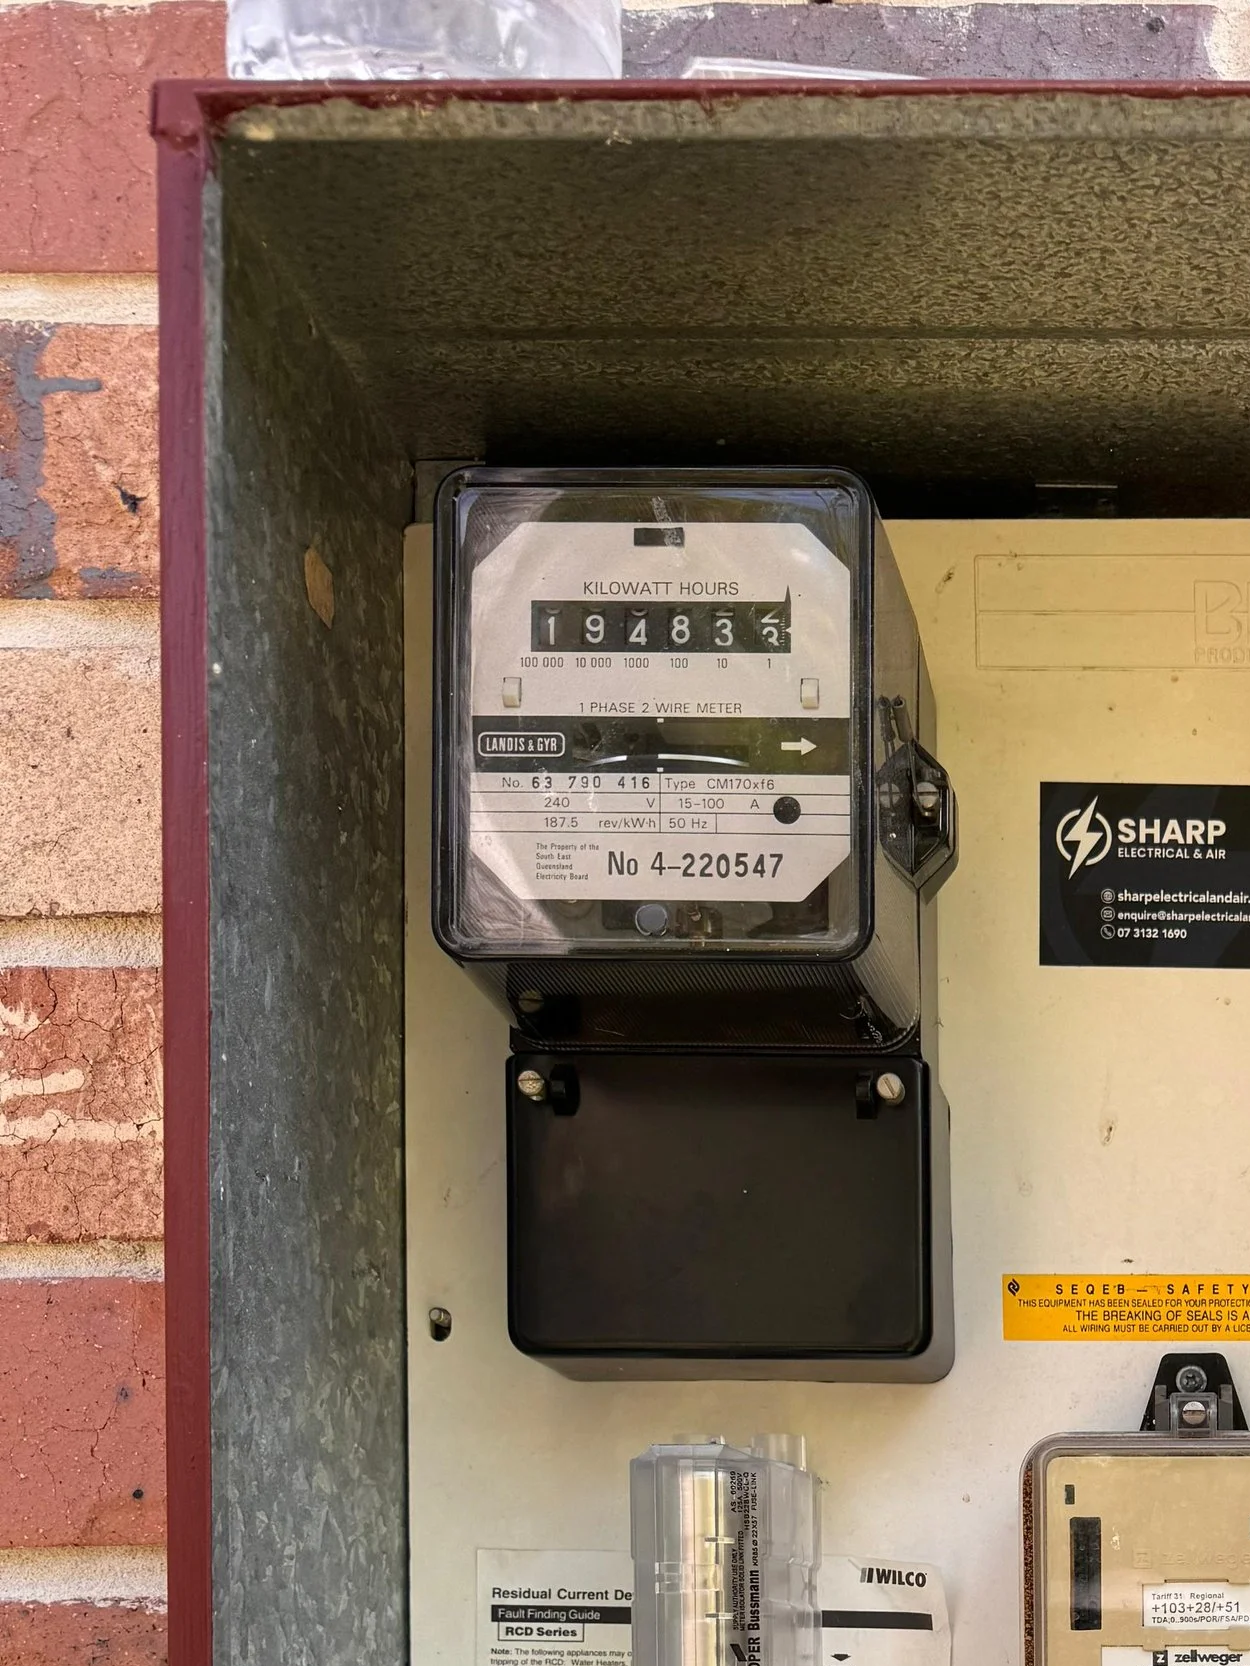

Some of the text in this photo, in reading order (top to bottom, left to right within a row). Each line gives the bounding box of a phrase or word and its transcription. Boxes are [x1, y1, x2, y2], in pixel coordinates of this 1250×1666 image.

[584, 582, 738, 595] KILOWATT HOURS
[591, 702, 634, 713] PHASE
[642, 703, 649, 713] 2
[656, 703, 689, 713] WIRE
[697, 703, 741, 713] METER
[486, 738, 557, 753] LANDIS & GYR
[502, 776, 649, 789] No. 63 790 416
[665, 778, 774, 791] Type CM170xf6
[544, 797, 655, 808] 240 V
[679, 798, 759, 809] 15-100 A
[1118, 819, 1226, 844] SHARP
[550, 843, 577, 852] Property
[1118, 848, 1225, 859] ELECTRICAL & AIR
[609, 851, 783, 878] No 4-220547
[1118, 928, 1187, 938] 07 3132 1690
[1056, 1284, 1124, 1294] SEQEB
[1167, 1284, 1248, 1294] SAFETY
[1018, 1299, 1036, 1307] THIS
[1039, 1299, 1086, 1307] EQUIPMENT
[1089, 1299, 1105, 1307] HAS
[1113, 1299, 1129, 1307] BEEN
[1132, 1299, 1163, 1307] SEALED
[1165, 1299, 1182, 1307] FOR
[1184, 1299, 1206, 1307] YOUR
[1076, 1310, 1098, 1321] THE
[1103, 1310, 1161, 1321] BREAKING
[1166, 1310, 1182, 1321] OF
[1185, 1310, 1222, 1321] SEALS
[1228, 1310, 1237, 1321] IS
[1080, 1324, 1110, 1332] WIRING
[1114, 1324, 1136, 1332] MUST
[1139, 1324, 1149, 1332] BE
[1153, 1324, 1189, 1332] CARRIED
[1192, 1324, 1208, 1332] OUT
[1212, 1324, 1221, 1332] BY
[1225, 1324, 1230, 1332] A
[876, 1568, 927, 1587] WILCO
[492, 1588, 608, 1600] Residual Current
[747, 1570, 760, 1630] Bussmann
[1152, 1602, 1239, 1614] +103+28/+51
[498, 1608, 600, 1621] Fault Finding Guide
[506, 1627, 577, 1636] RCD Series
[1175, 1650, 1242, 1665] zellweger
